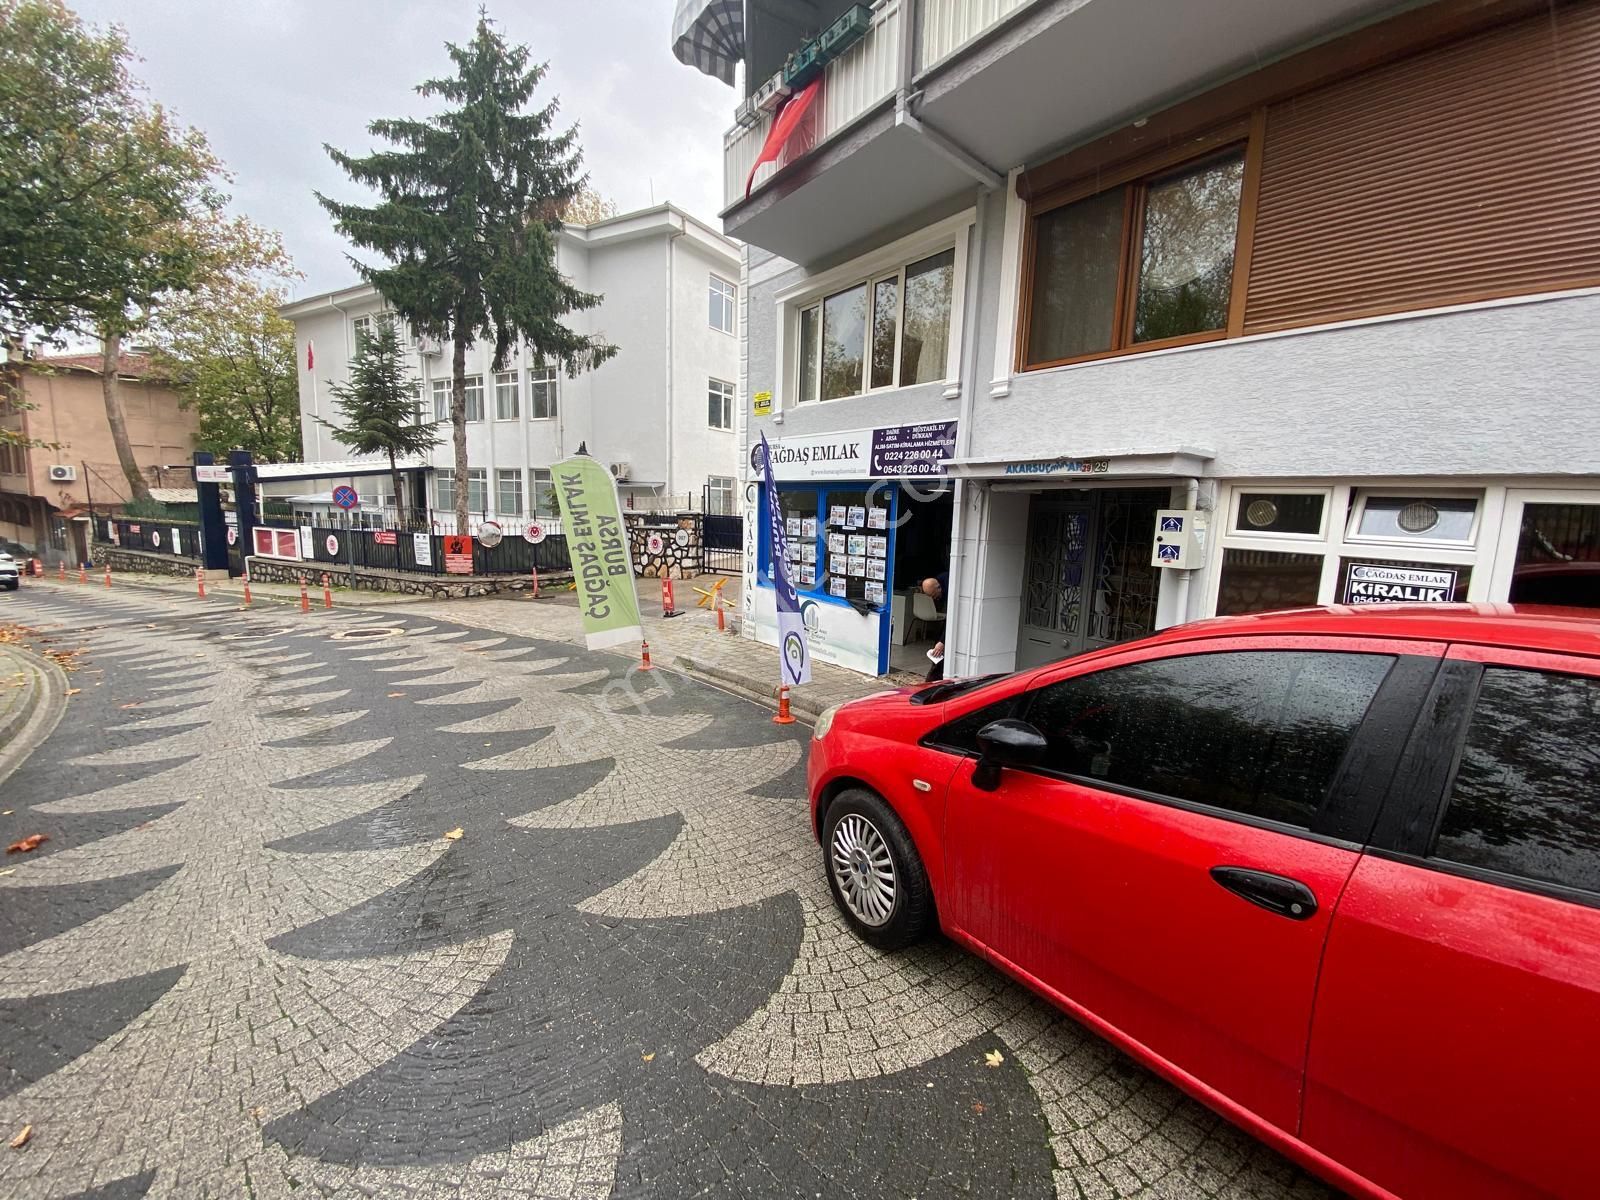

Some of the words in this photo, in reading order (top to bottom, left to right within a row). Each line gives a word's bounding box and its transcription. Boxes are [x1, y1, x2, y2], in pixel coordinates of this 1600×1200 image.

[812, 443, 860, 461] EMLAK
[884, 452, 903, 461] 0224
[904, 450, 920, 460] 226
[920, 449, 931, 459] 00
[932, 448, 944, 458] 44
[883, 465, 902, 474] 0543
[903, 464, 918, 473] 226
[919, 463, 930, 473] 00
[931, 463, 942, 473] 44
[1006, 463, 1045, 473] AKARSU
[1094, 460, 1109, 473] 29
[1365, 569, 1406, 581] ÇAĞDAŞ
[1408, 575, 1448, 584] EMLAK
